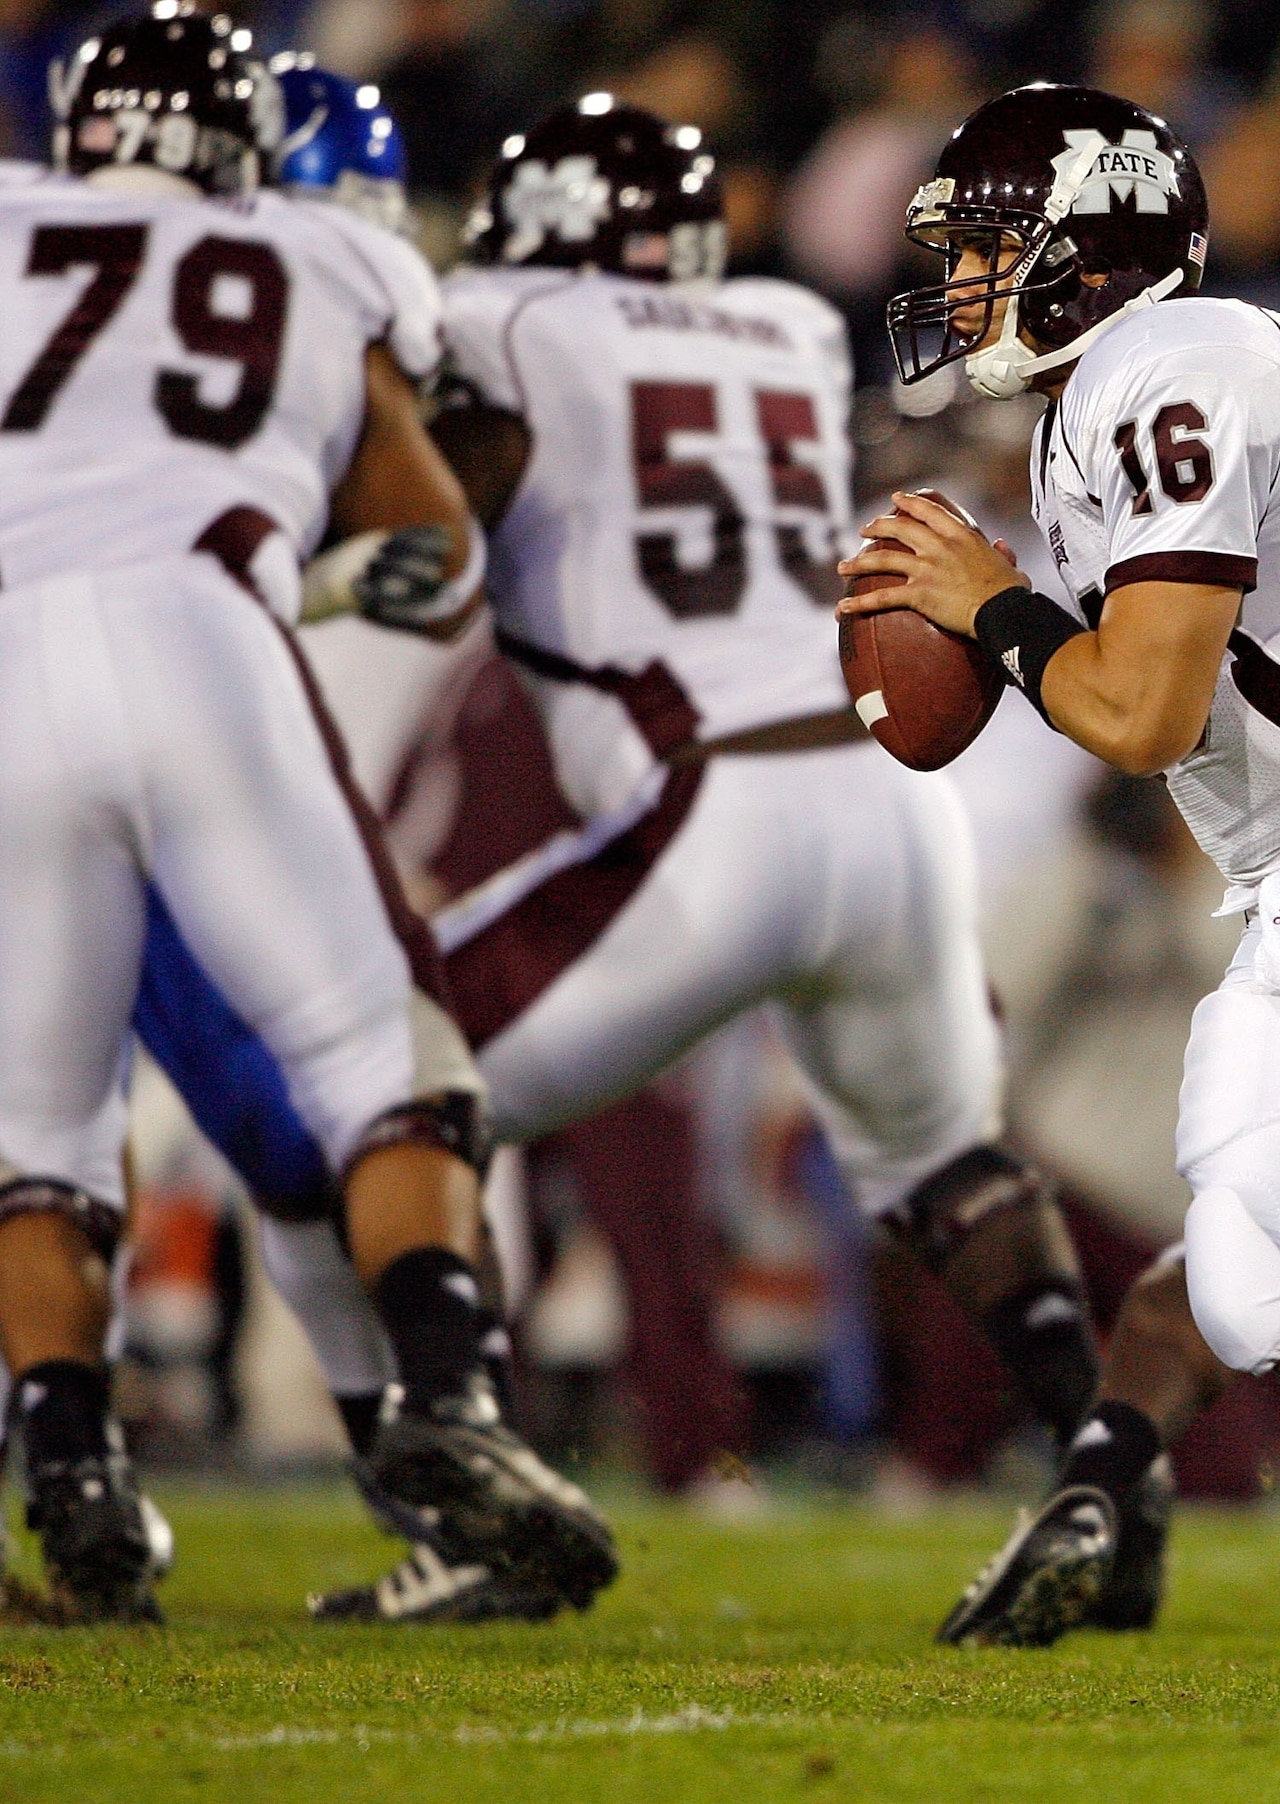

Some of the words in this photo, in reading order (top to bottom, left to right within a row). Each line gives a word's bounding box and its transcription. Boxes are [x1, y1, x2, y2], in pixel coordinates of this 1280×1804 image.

[112, 110, 196, 171] 79
[1084, 151, 1159, 182] TATE
[0, 221, 292, 453] 79
[628, 378, 850, 622] 55
[1110, 398, 1217, 520] 16
